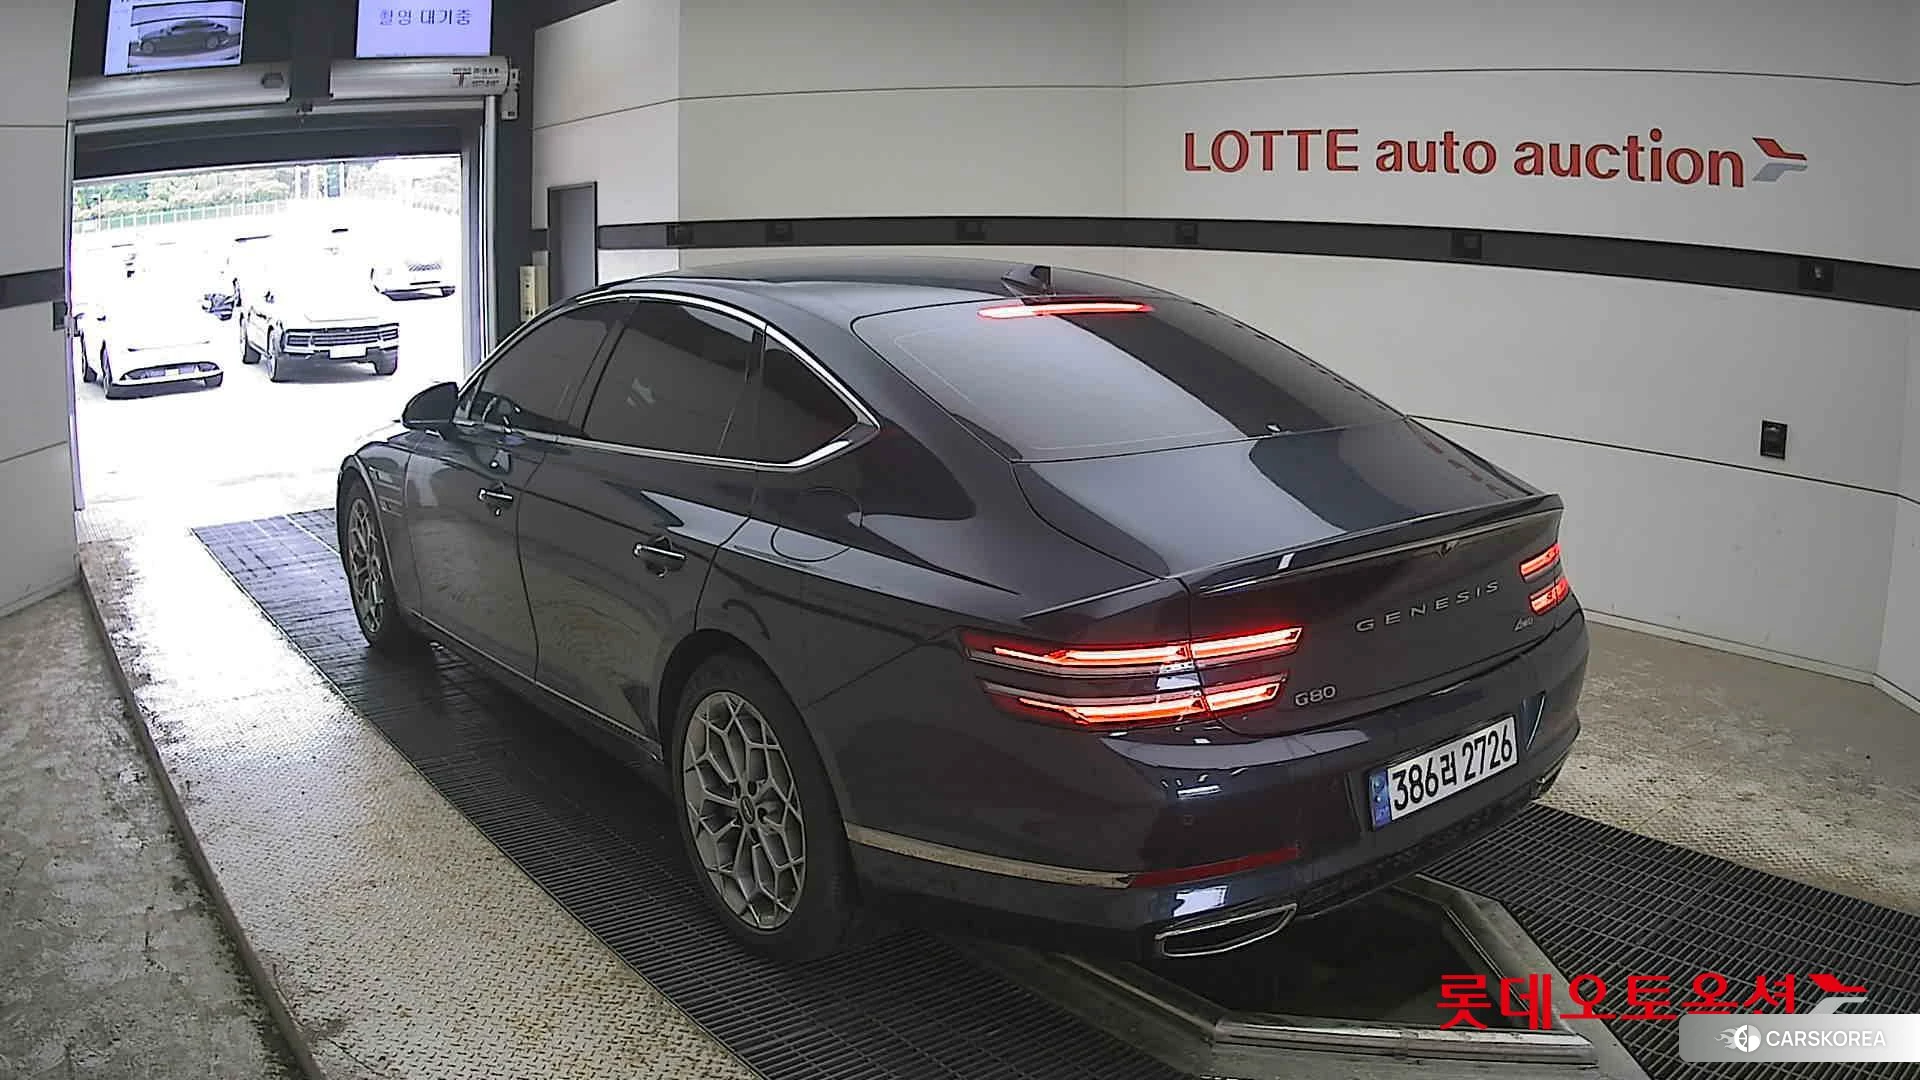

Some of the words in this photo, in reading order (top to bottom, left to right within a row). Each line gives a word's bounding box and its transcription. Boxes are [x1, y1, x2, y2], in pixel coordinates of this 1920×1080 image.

[420, 8, 471, 26] 대기중
[1185, 128, 1359, 173] LOTTE
[1376, 131, 1497, 175] auto
[1514, 128, 1745, 188] auction
[1356, 580, 1498, 632] GENESIS
[1295, 686, 1337, 706] G80
[1391, 751, 1458, 811] 386러
[1462, 724, 1513, 782] 2726
